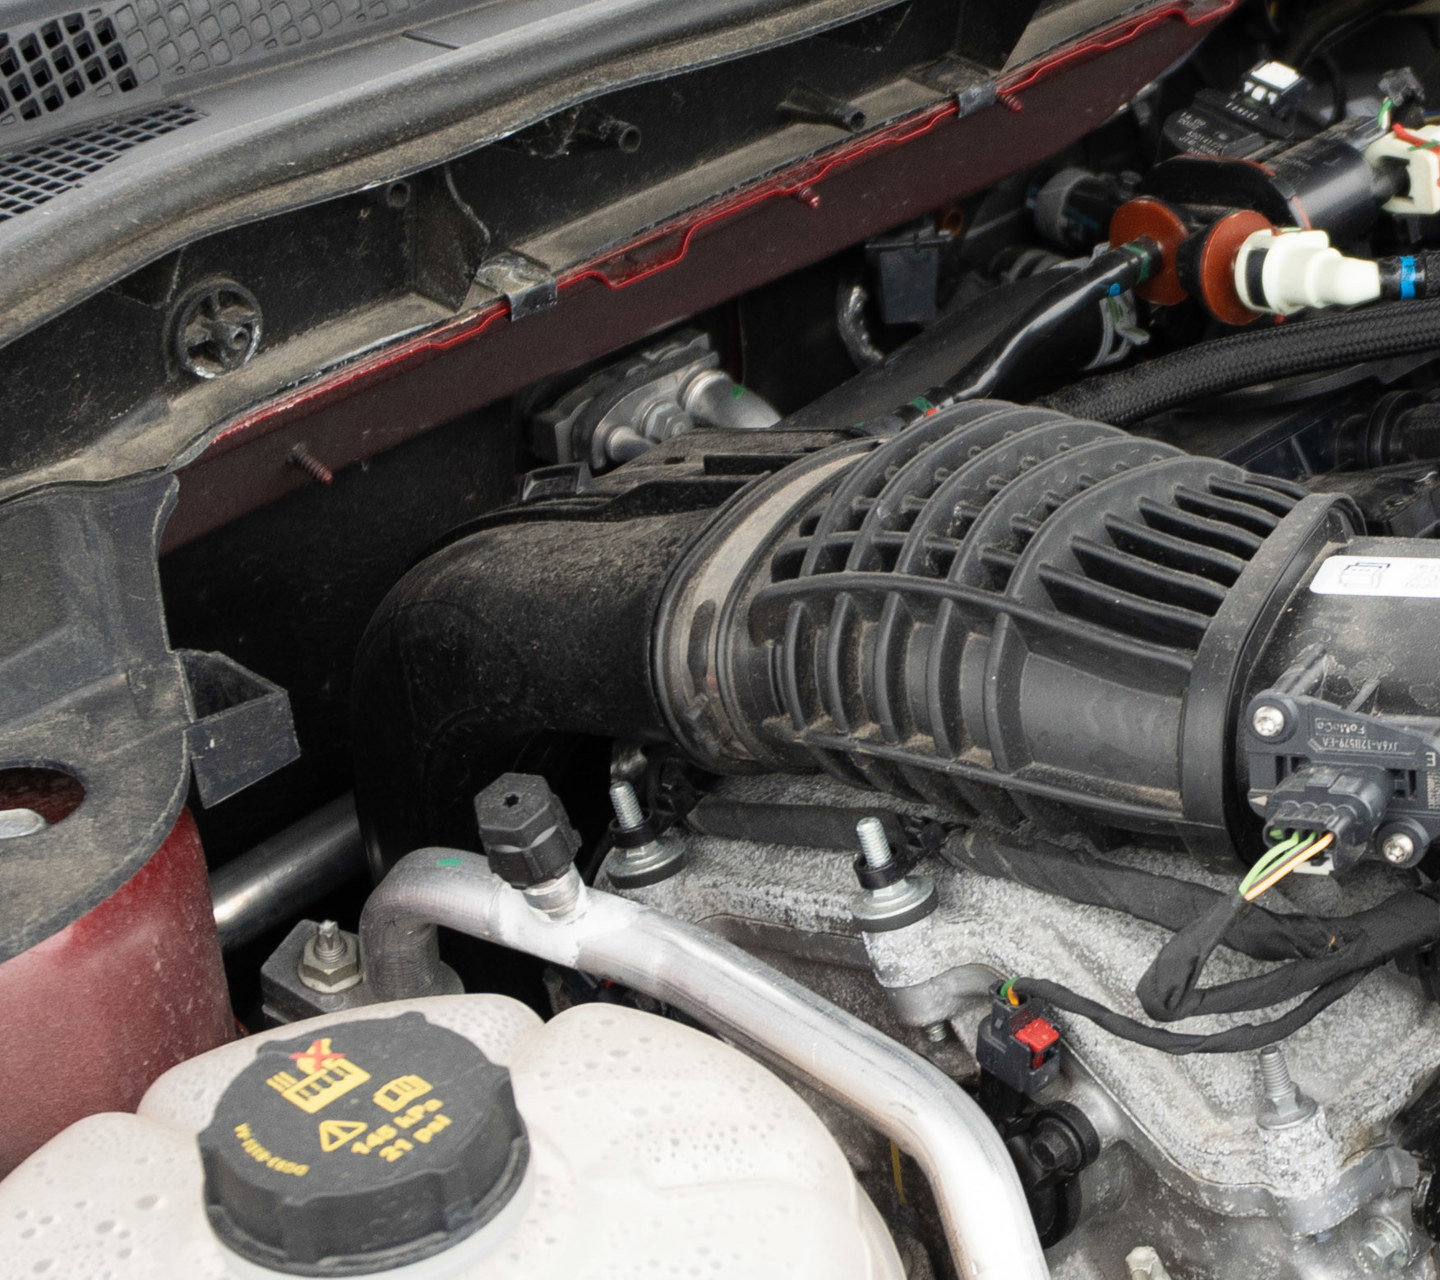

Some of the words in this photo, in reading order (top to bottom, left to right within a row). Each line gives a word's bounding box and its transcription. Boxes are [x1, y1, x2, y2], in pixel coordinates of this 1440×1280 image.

[1425, 752, 1437, 767] E
[351, 1125, 398, 1156] 145
[379, 1138, 415, 1163] 21
[413, 1114, 453, 1145] psi
